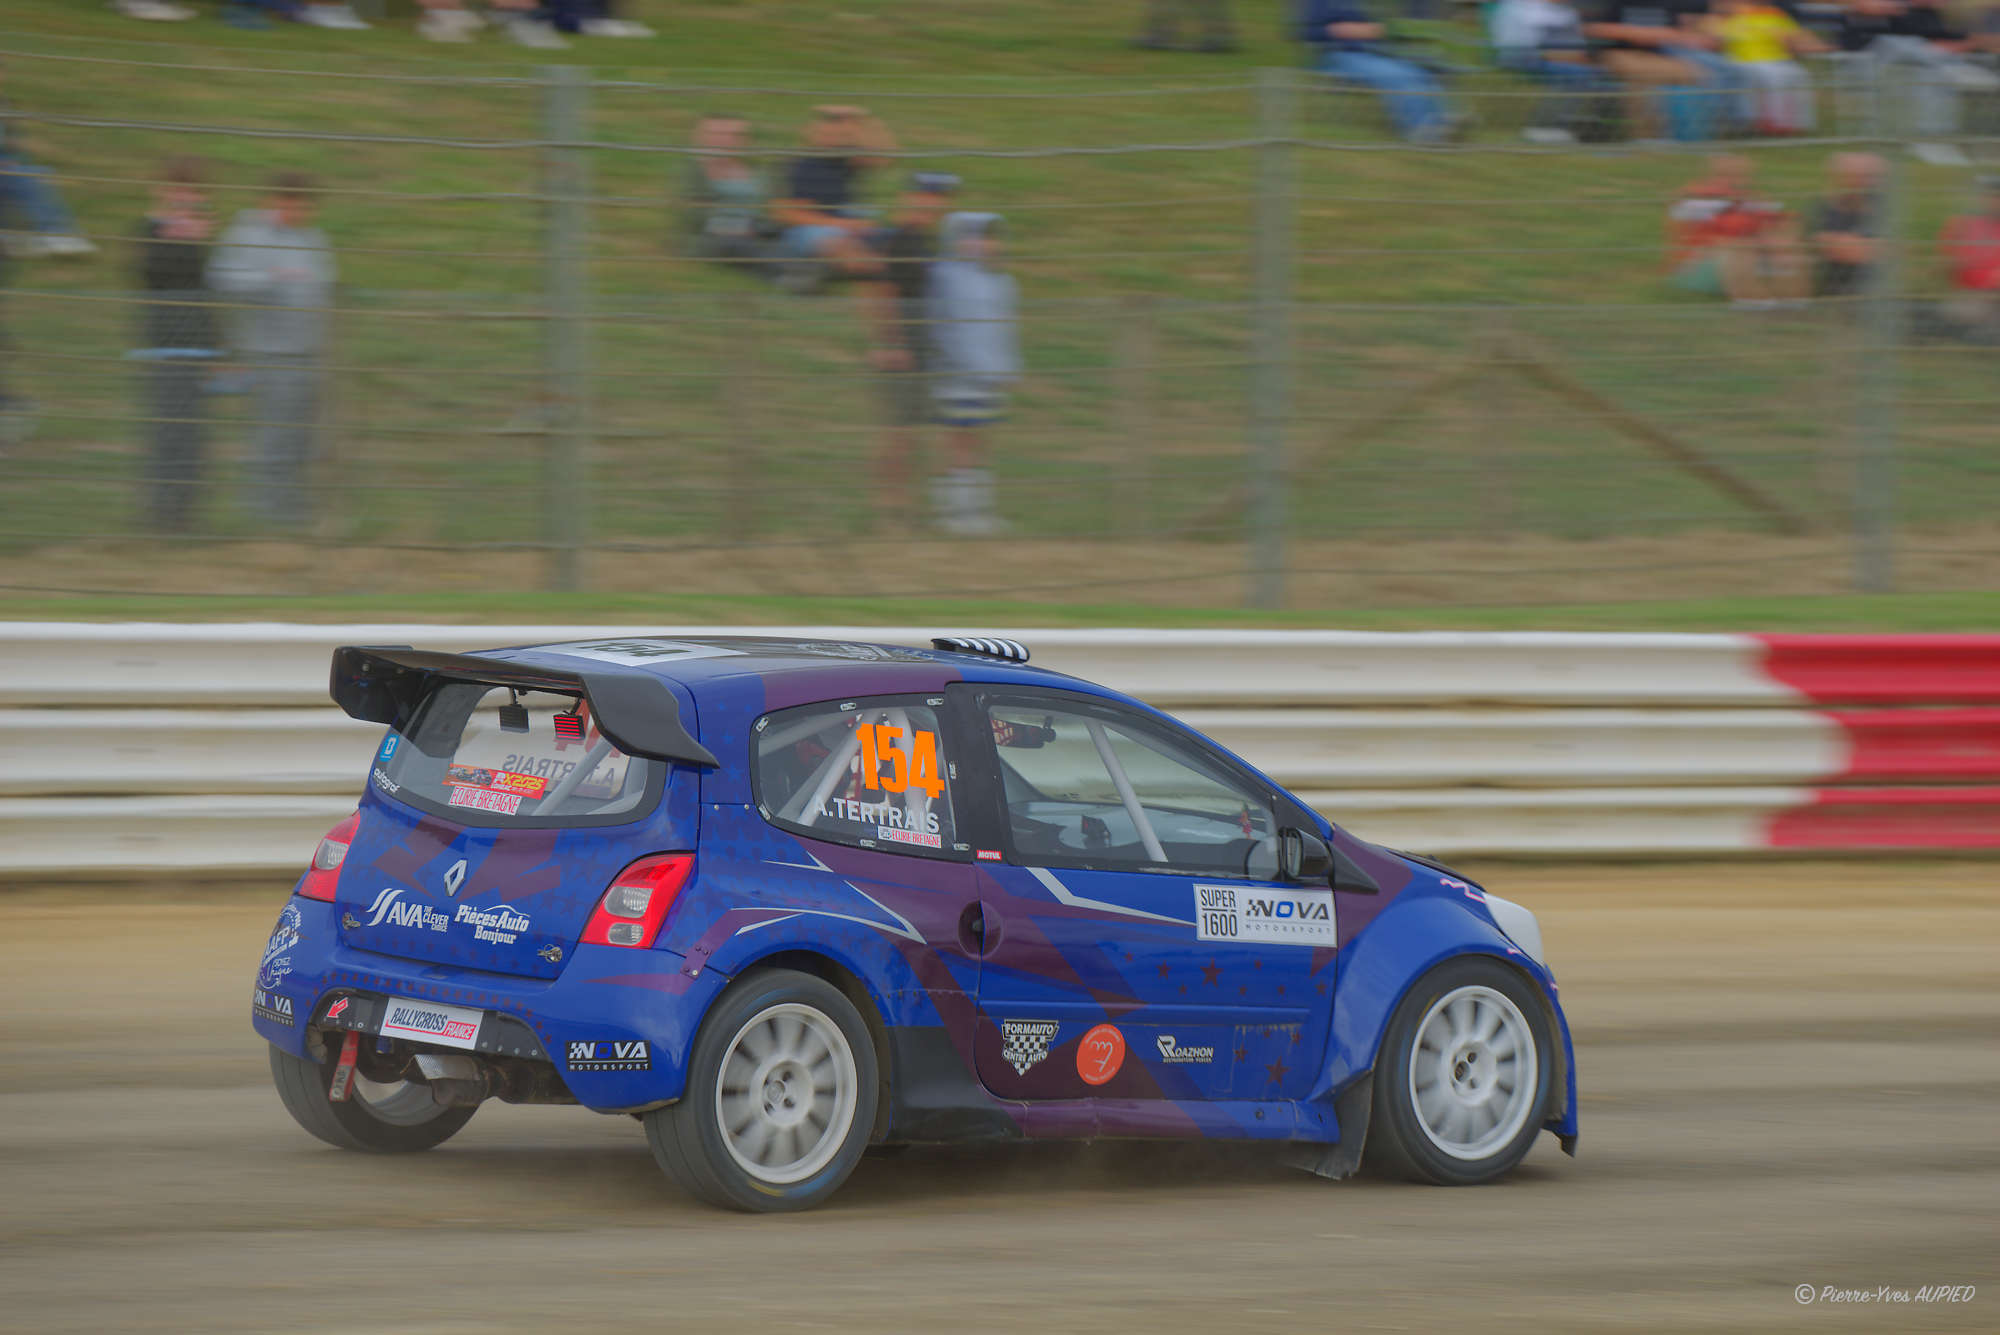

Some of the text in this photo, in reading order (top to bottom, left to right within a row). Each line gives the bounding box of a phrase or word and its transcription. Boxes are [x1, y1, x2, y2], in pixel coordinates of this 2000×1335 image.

[856, 722, 945, 799] 154
[477, 790, 521, 814] BRETAGNE
[815, 798, 939, 834] A.TERTRAIS
[977, 852, 1001, 860] MOTUL
[1200, 889, 1236, 908] SUPER
[1246, 899, 1330, 920] NOVA
[423, 911, 449, 928] CLEVER
[1202, 913, 1238, 937] 1600
[474, 925, 516, 945] Bonjour
[390, 1007, 448, 1032] RALLYCROSS
[443, 1022, 474, 1040] FRANCE
[1006, 1024, 1054, 1035] FORMAUTO
[569, 1042, 648, 1059] NOVA
[1003, 1049, 1048, 1062] CENTRE AUTO
[1156, 1035, 1214, 1058] ROAZHON
[569, 1063, 649, 1071] MOTORSPORT
